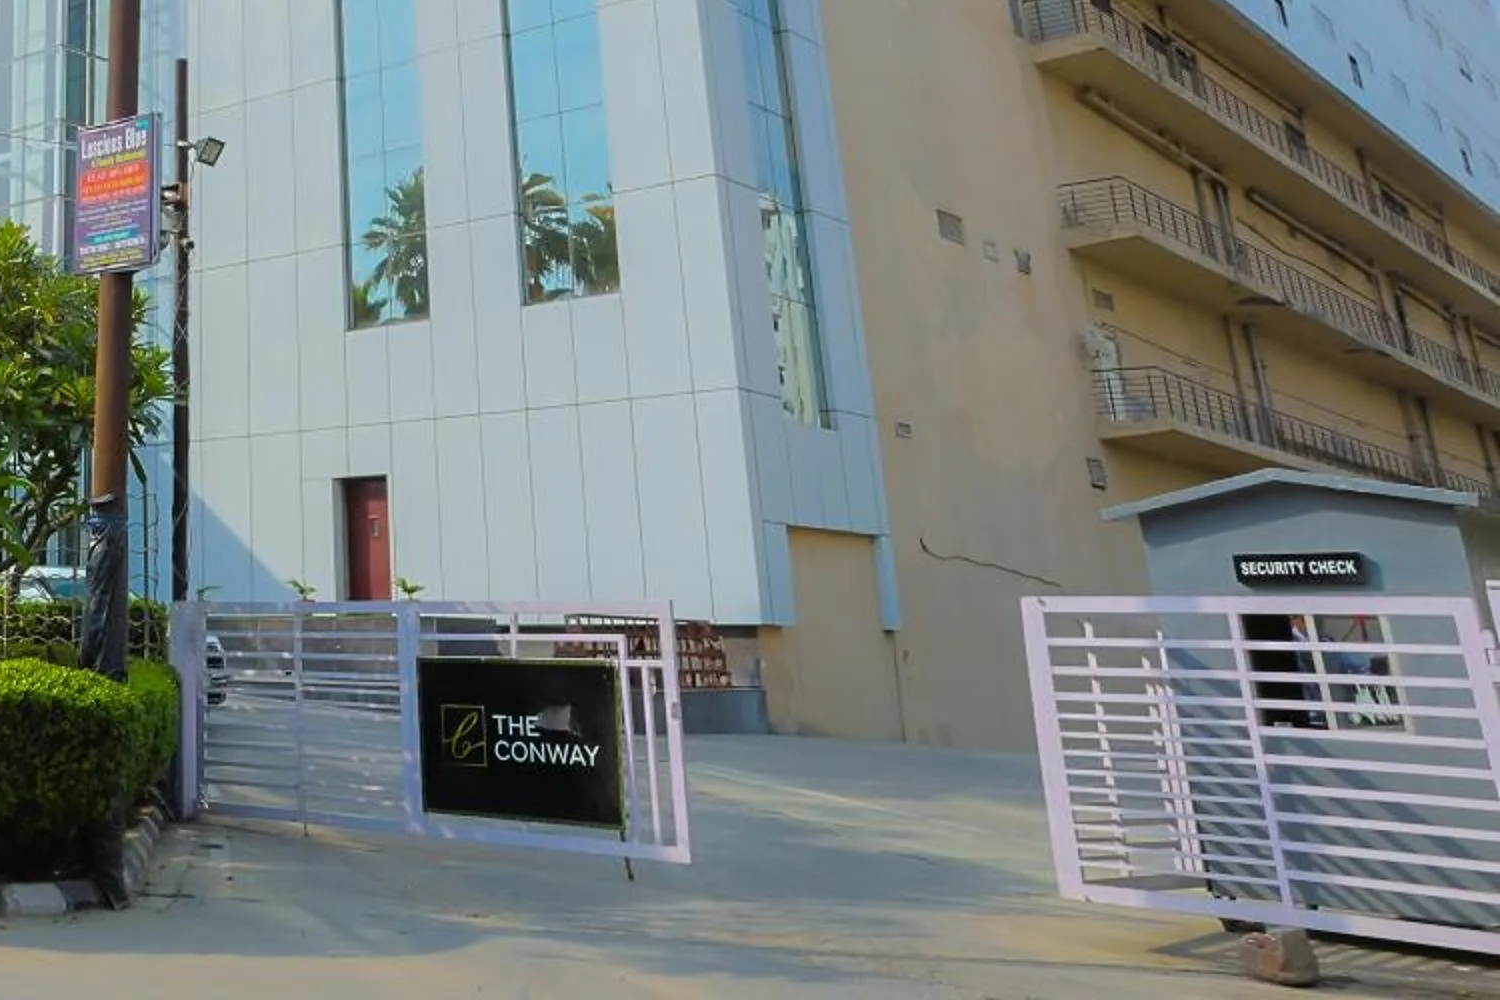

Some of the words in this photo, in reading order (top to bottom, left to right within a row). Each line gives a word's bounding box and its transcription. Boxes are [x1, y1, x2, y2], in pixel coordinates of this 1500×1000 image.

[1240, 561, 1305, 576] SECURITY
[1308, 560, 1358, 575] CHECK
[491, 714, 541, 738] THE
[494, 740, 600, 767] CONWAY
